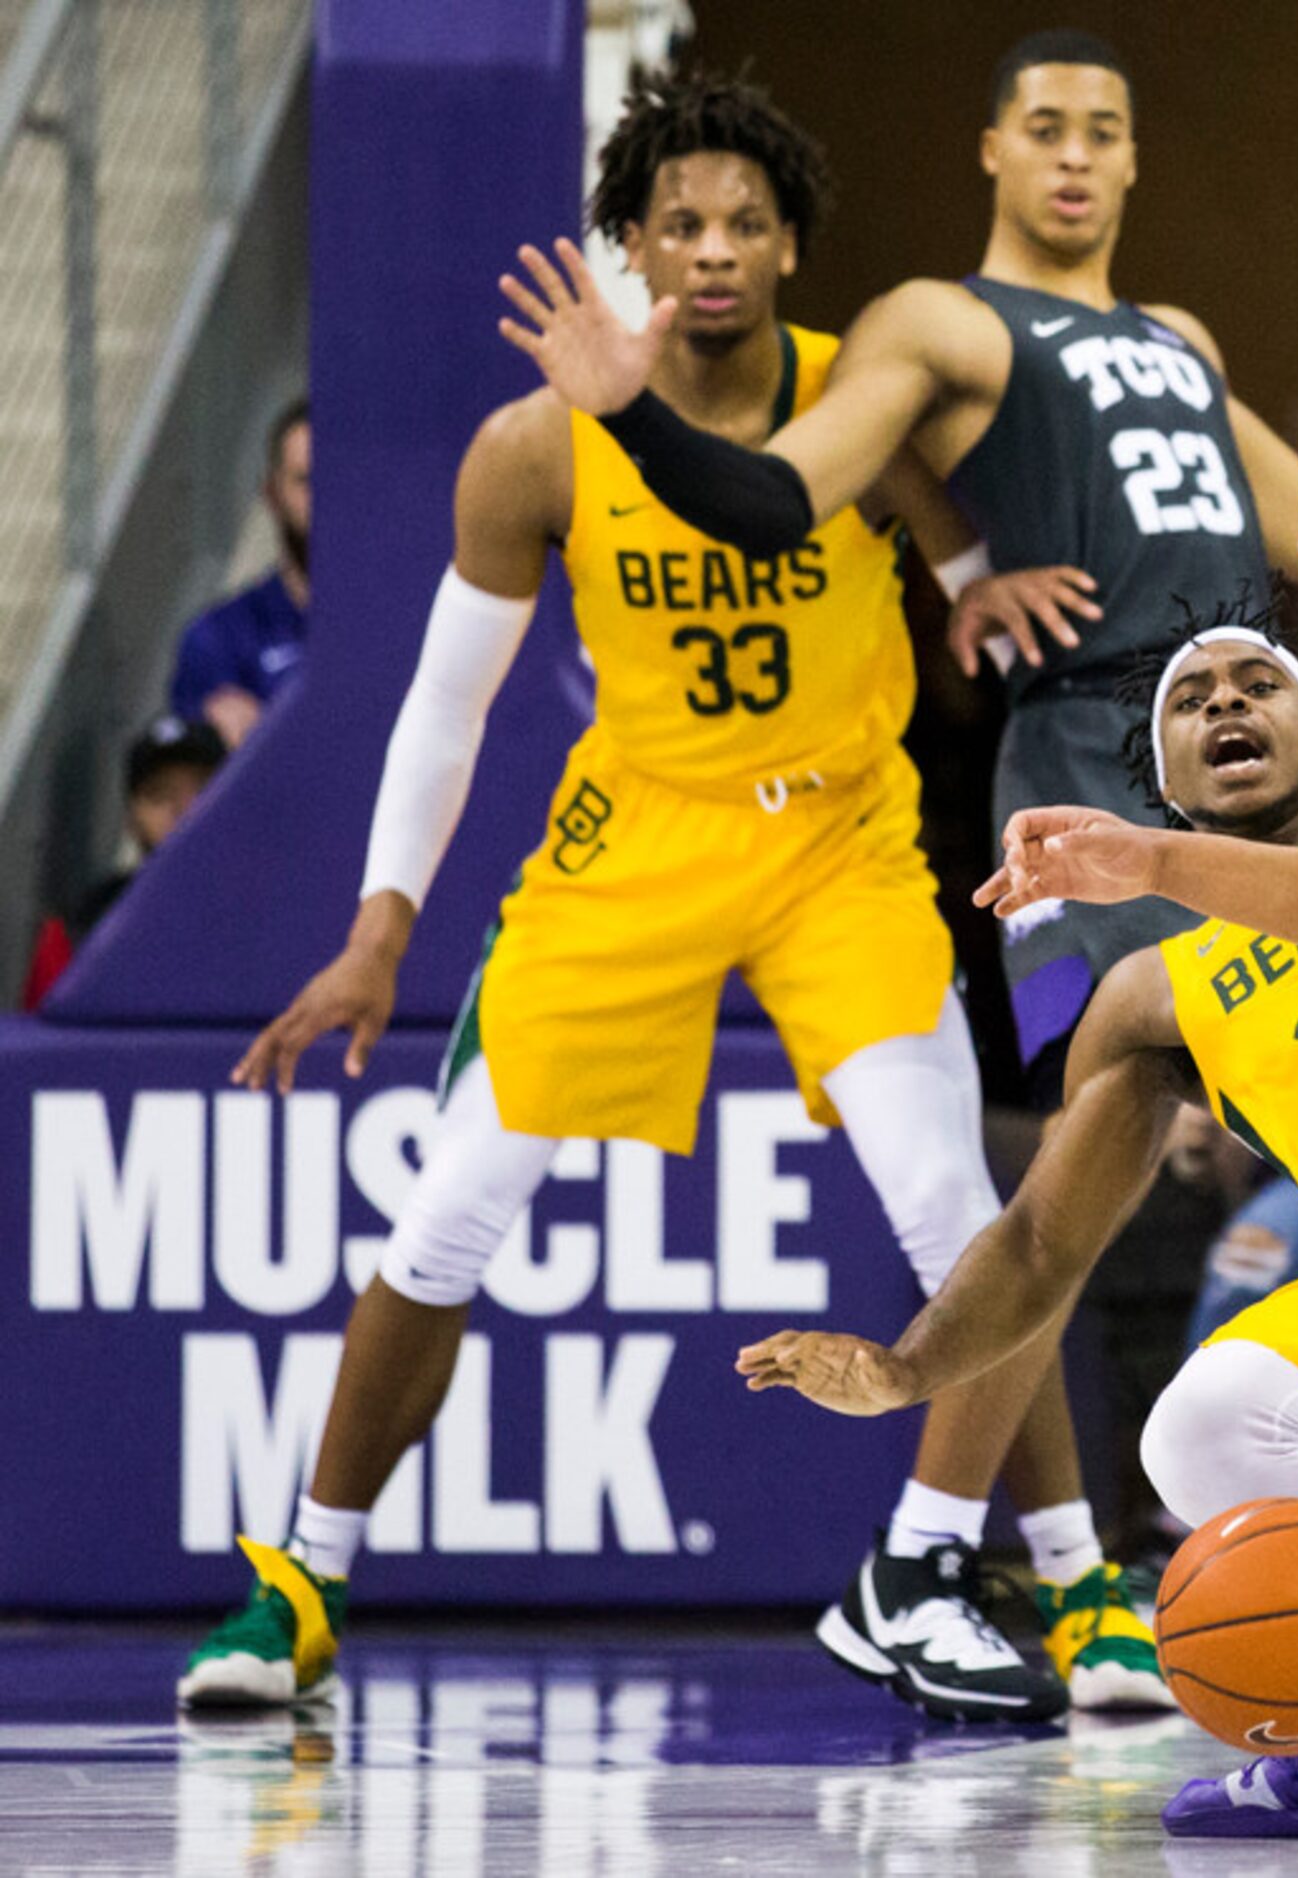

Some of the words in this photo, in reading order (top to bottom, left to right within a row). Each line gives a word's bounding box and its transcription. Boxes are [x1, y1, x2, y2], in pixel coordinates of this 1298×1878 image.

[1059, 335, 1213, 412] TCU
[1109, 428, 1244, 536] 23
[615, 541, 828, 612] BEARS
[671, 621, 792, 717] 33
